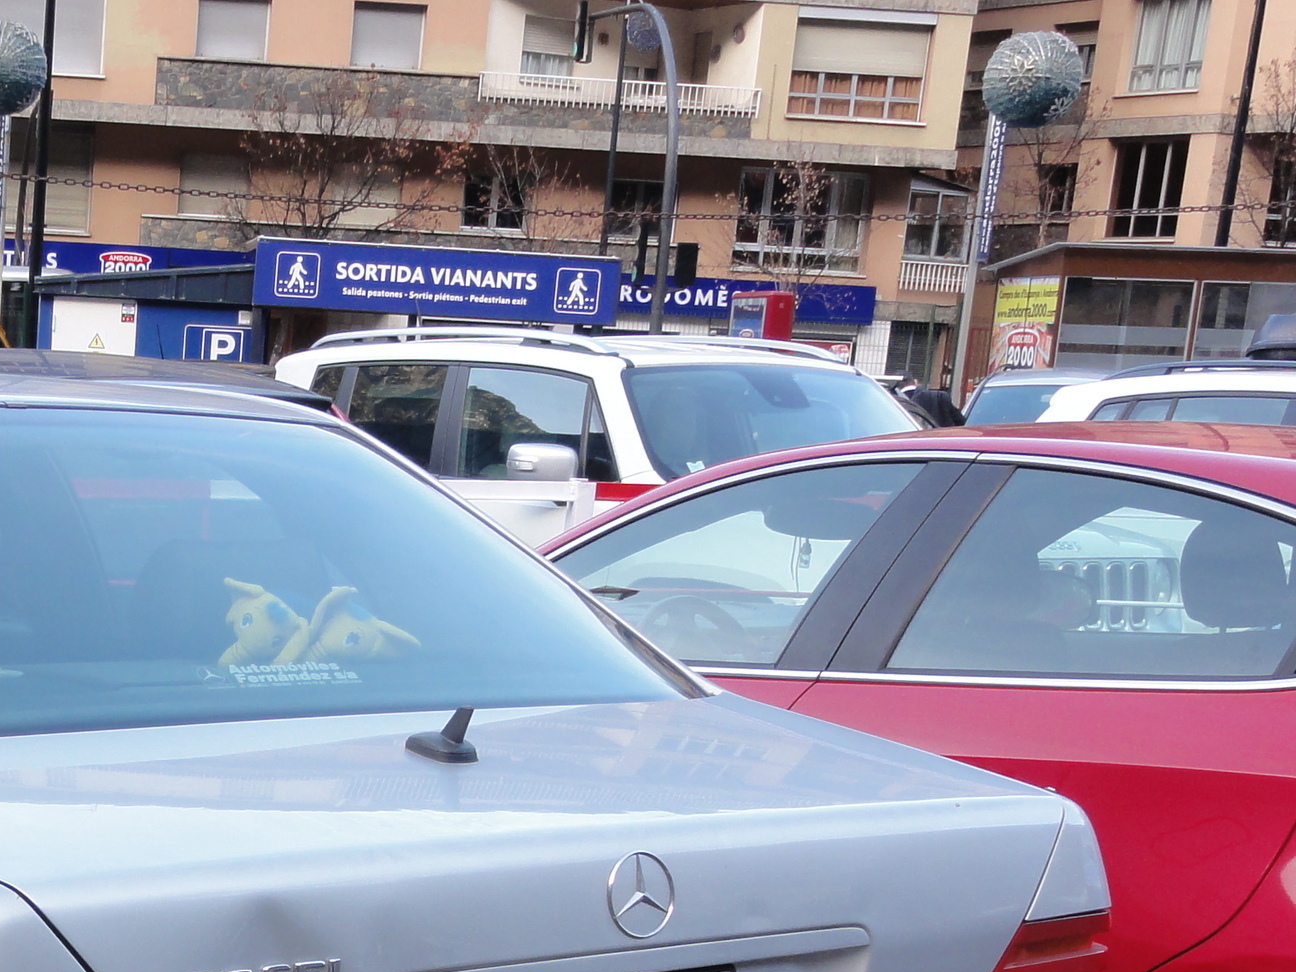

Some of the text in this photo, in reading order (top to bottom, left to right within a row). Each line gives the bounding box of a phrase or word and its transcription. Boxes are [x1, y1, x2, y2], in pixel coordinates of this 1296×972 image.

[109, 254, 143, 262] ANDORRA
[104, 261, 146, 273] 2000
[335, 261, 538, 291] SORTIDA VIANANTS
[342, 286, 366, 297] Salida
[368, 289, 403, 300] peatones
[409, 291, 433, 300] Sortie
[434, 291, 463, 303] piétons
[470, 294, 510, 305] Pedestrian
[511, 297, 527, 306] exit
[209, 333, 235, 361] P
[1007, 345, 1034, 367] 2000
[229, 661, 339, 674] Automóviles
[235, 670, 358, 683] Fernández s/a
